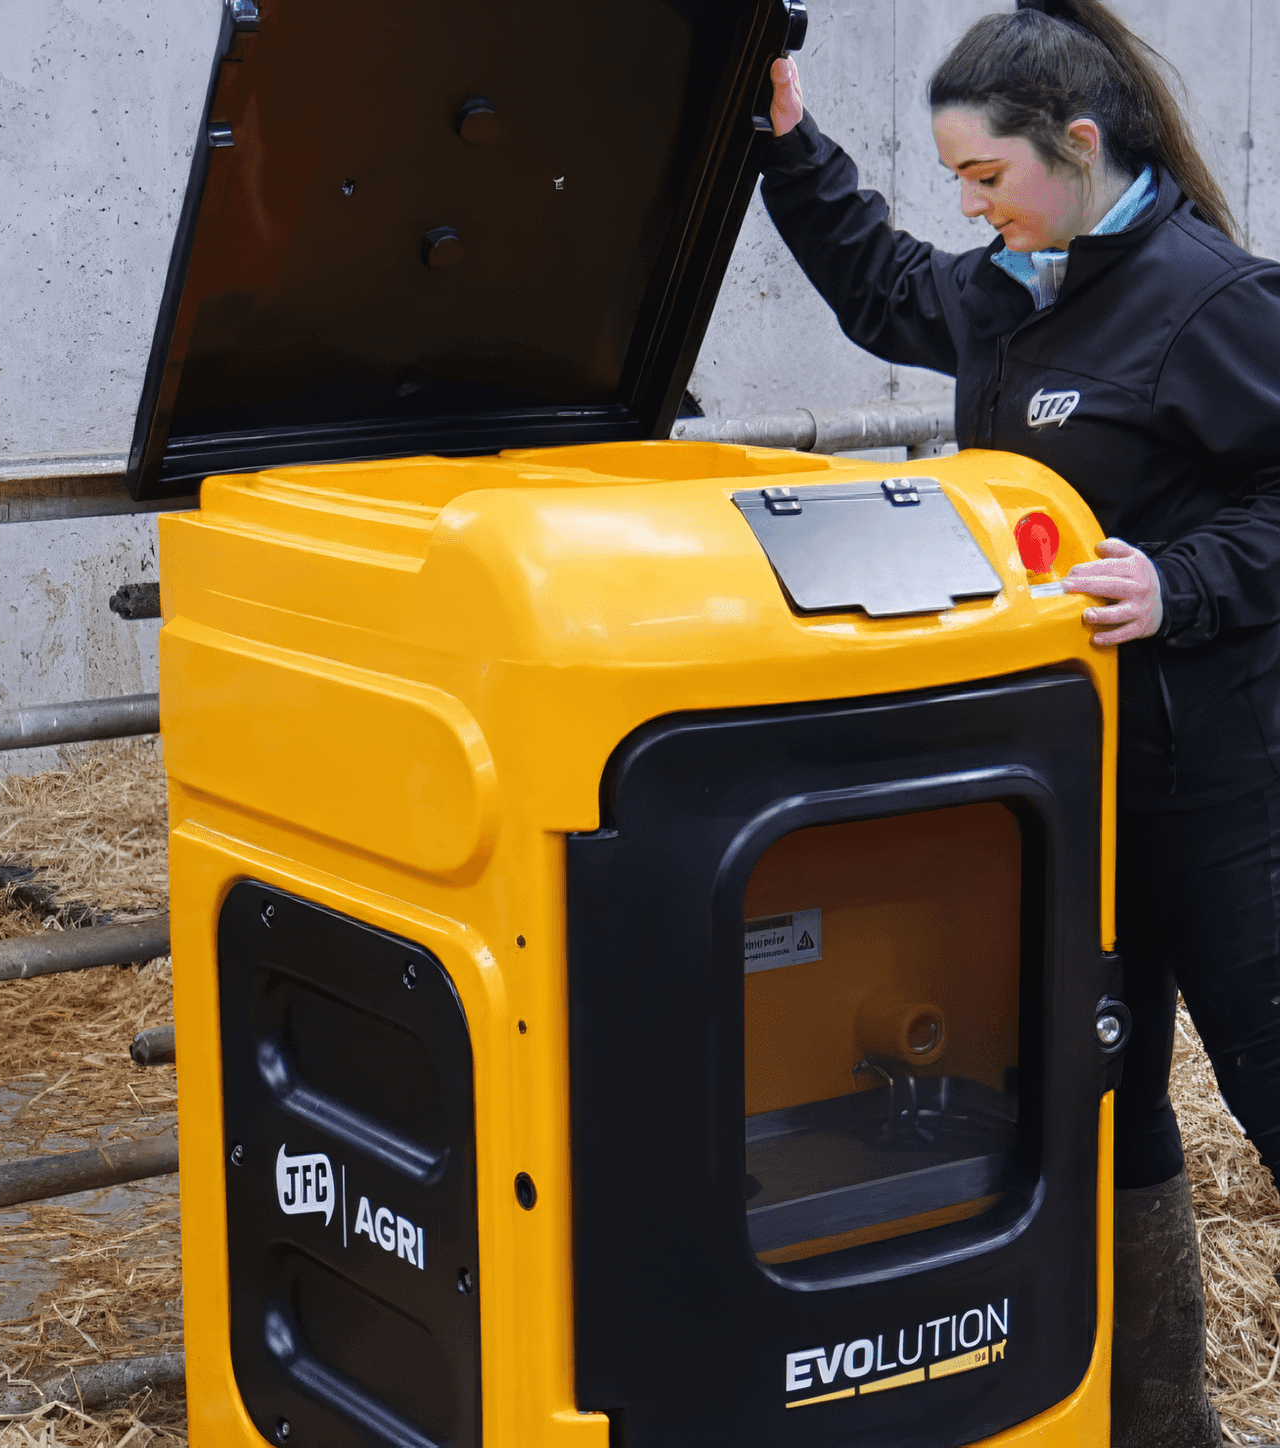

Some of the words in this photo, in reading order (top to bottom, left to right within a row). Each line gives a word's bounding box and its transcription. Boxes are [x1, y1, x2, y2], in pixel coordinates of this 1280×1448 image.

[1030, 394, 1077, 422] JFC
[282, 1160, 329, 1207] JFC
[354, 1196, 425, 1271] AGRI
[785, 1298, 1009, 1392] EVOLUTION
